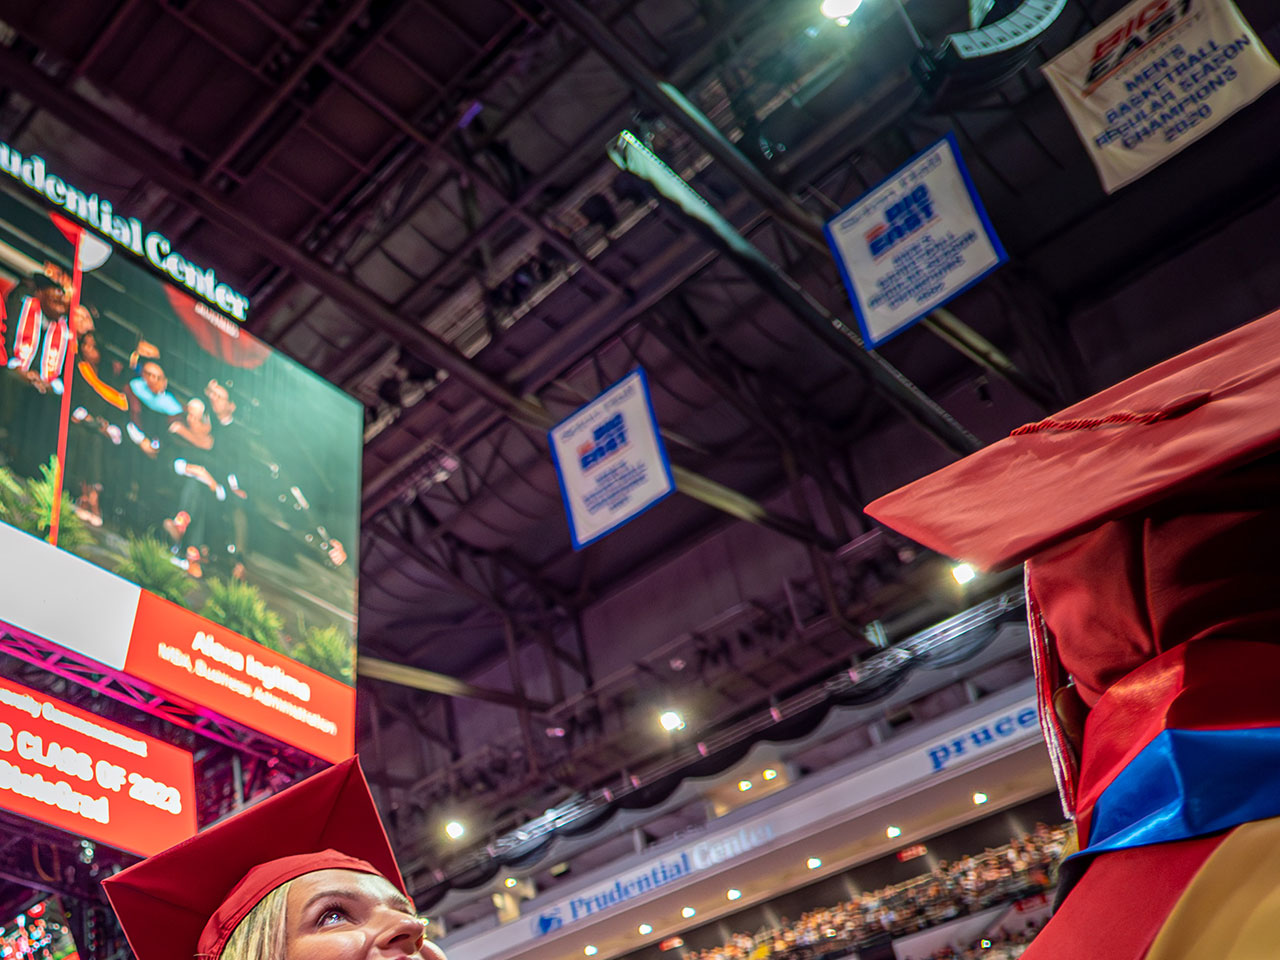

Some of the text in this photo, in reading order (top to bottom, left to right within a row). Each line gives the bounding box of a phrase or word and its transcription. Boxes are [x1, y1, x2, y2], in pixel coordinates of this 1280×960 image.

[1094, 92, 1177, 148] REGULAR
[1178, 33, 1251, 93] SEASON
[1106, 39, 1221, 123] BASKETBALL
[1121, 65, 1238, 150] CHAMPIONS
[1123, 43, 1187, 93] MEN'S
[1164, 102, 1212, 143] 2020
[144, 231, 250, 322] Center
[17, 730, 94, 782] CLASS
[95, 760, 127, 792] OF
[570, 851, 691, 920] Prudential
[692, 822, 775, 871] Center
